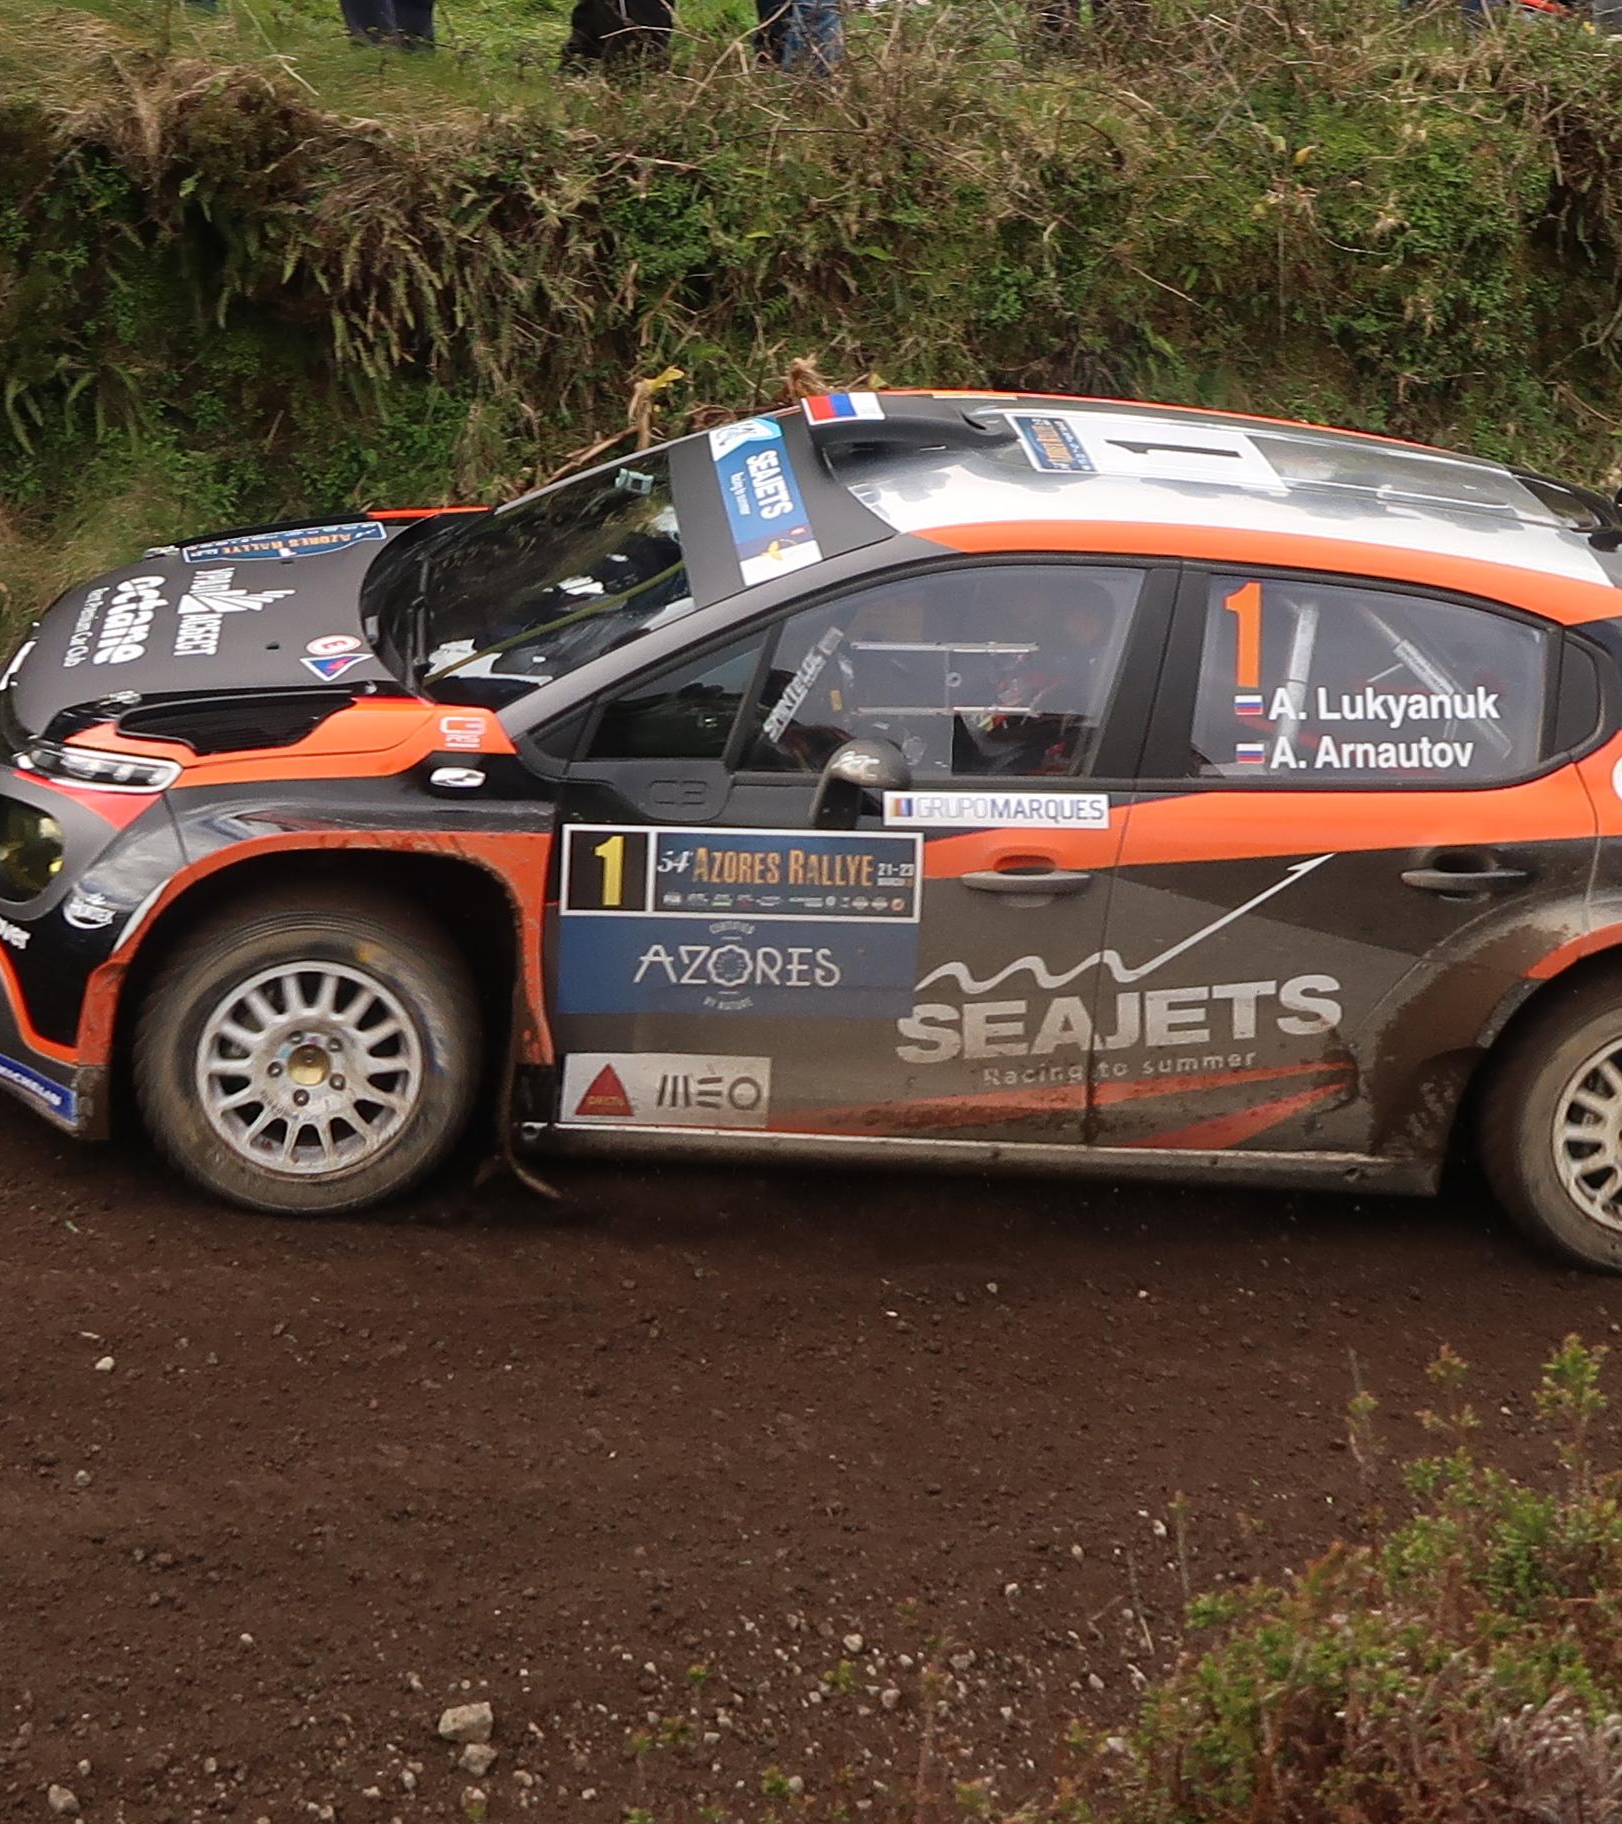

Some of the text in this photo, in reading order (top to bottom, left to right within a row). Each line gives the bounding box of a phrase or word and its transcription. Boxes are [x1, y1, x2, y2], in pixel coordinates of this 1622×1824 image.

[745, 450, 794, 520] SEAJETS
[92, 575, 170, 665] octane
[173, 613, 224, 657] АСБЕСТ
[1224, 580, 1264, 689] 1
[1268, 686, 1501, 729] A. Lukyanuk
[1269, 735, 1474, 769] A. Arnautov
[593, 834, 626, 907] 1
[692, 846, 782, 885] AZORES
[787, 848, 875, 887] RALLYE
[633, 943, 842, 988] AZORES
[895, 973, 1344, 1065] SEAJETS
[982, 1049, 1258, 1088] Racing to summer
